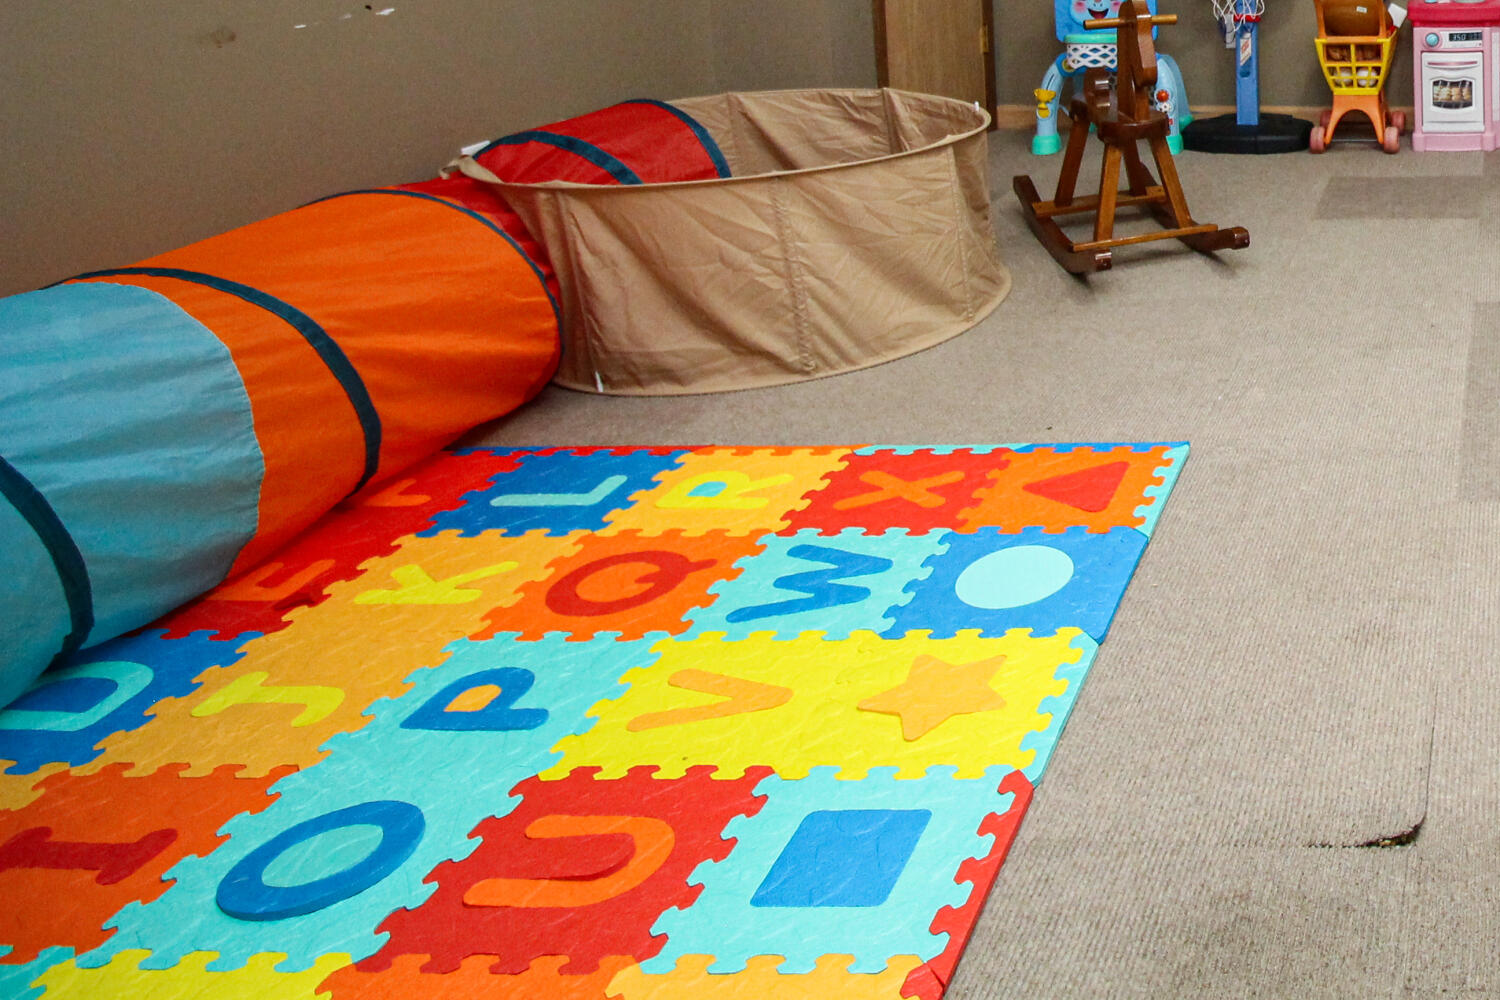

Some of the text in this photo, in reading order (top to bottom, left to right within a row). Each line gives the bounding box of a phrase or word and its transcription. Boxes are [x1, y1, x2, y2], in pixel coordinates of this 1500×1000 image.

[655, 470, 794, 509] R
[833, 470, 965, 509] X
[353, 563, 520, 604] K
[544, 550, 717, 617] Q
[725, 544, 893, 623] W
[399, 667, 550, 732] P
[626, 668, 794, 732] V
[216, 800, 426, 922] O
[463, 814, 676, 908] U
